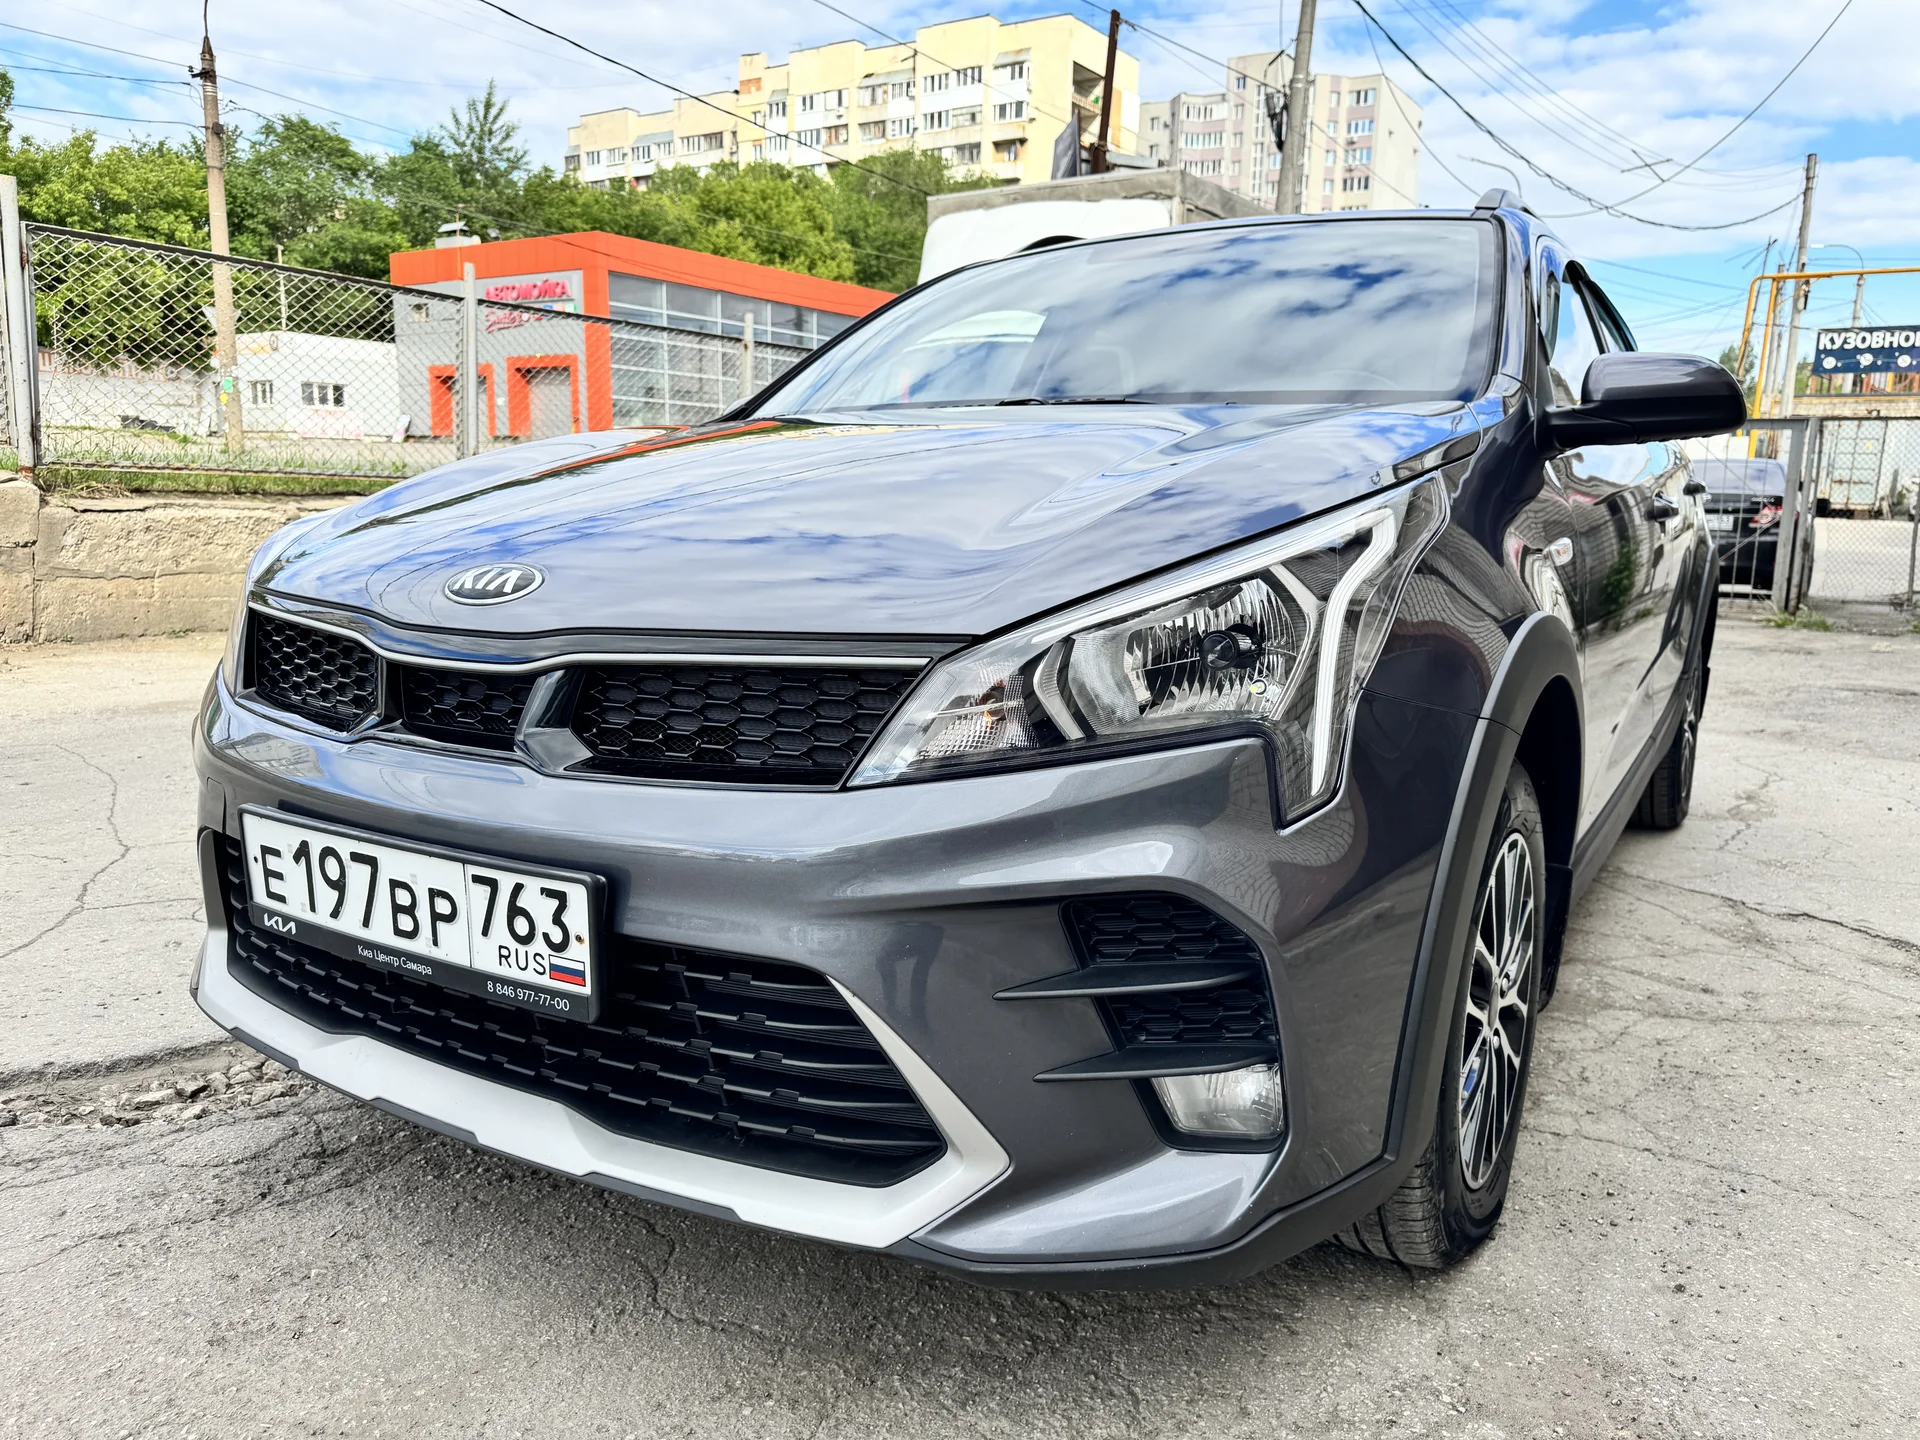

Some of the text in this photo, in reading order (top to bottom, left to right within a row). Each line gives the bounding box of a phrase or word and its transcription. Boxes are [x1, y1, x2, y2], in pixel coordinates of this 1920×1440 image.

[485, 278, 572, 301] АВТОМОЙКА
[453, 566, 524, 594] KIA
[263, 912, 297, 935] KIA
[471, 873, 571, 954] 763
[357, 944, 433, 976] Киа Центр Самара
[498, 944, 547, 976] RUS
[487, 980, 570, 1012] 8 846 977-77-00
